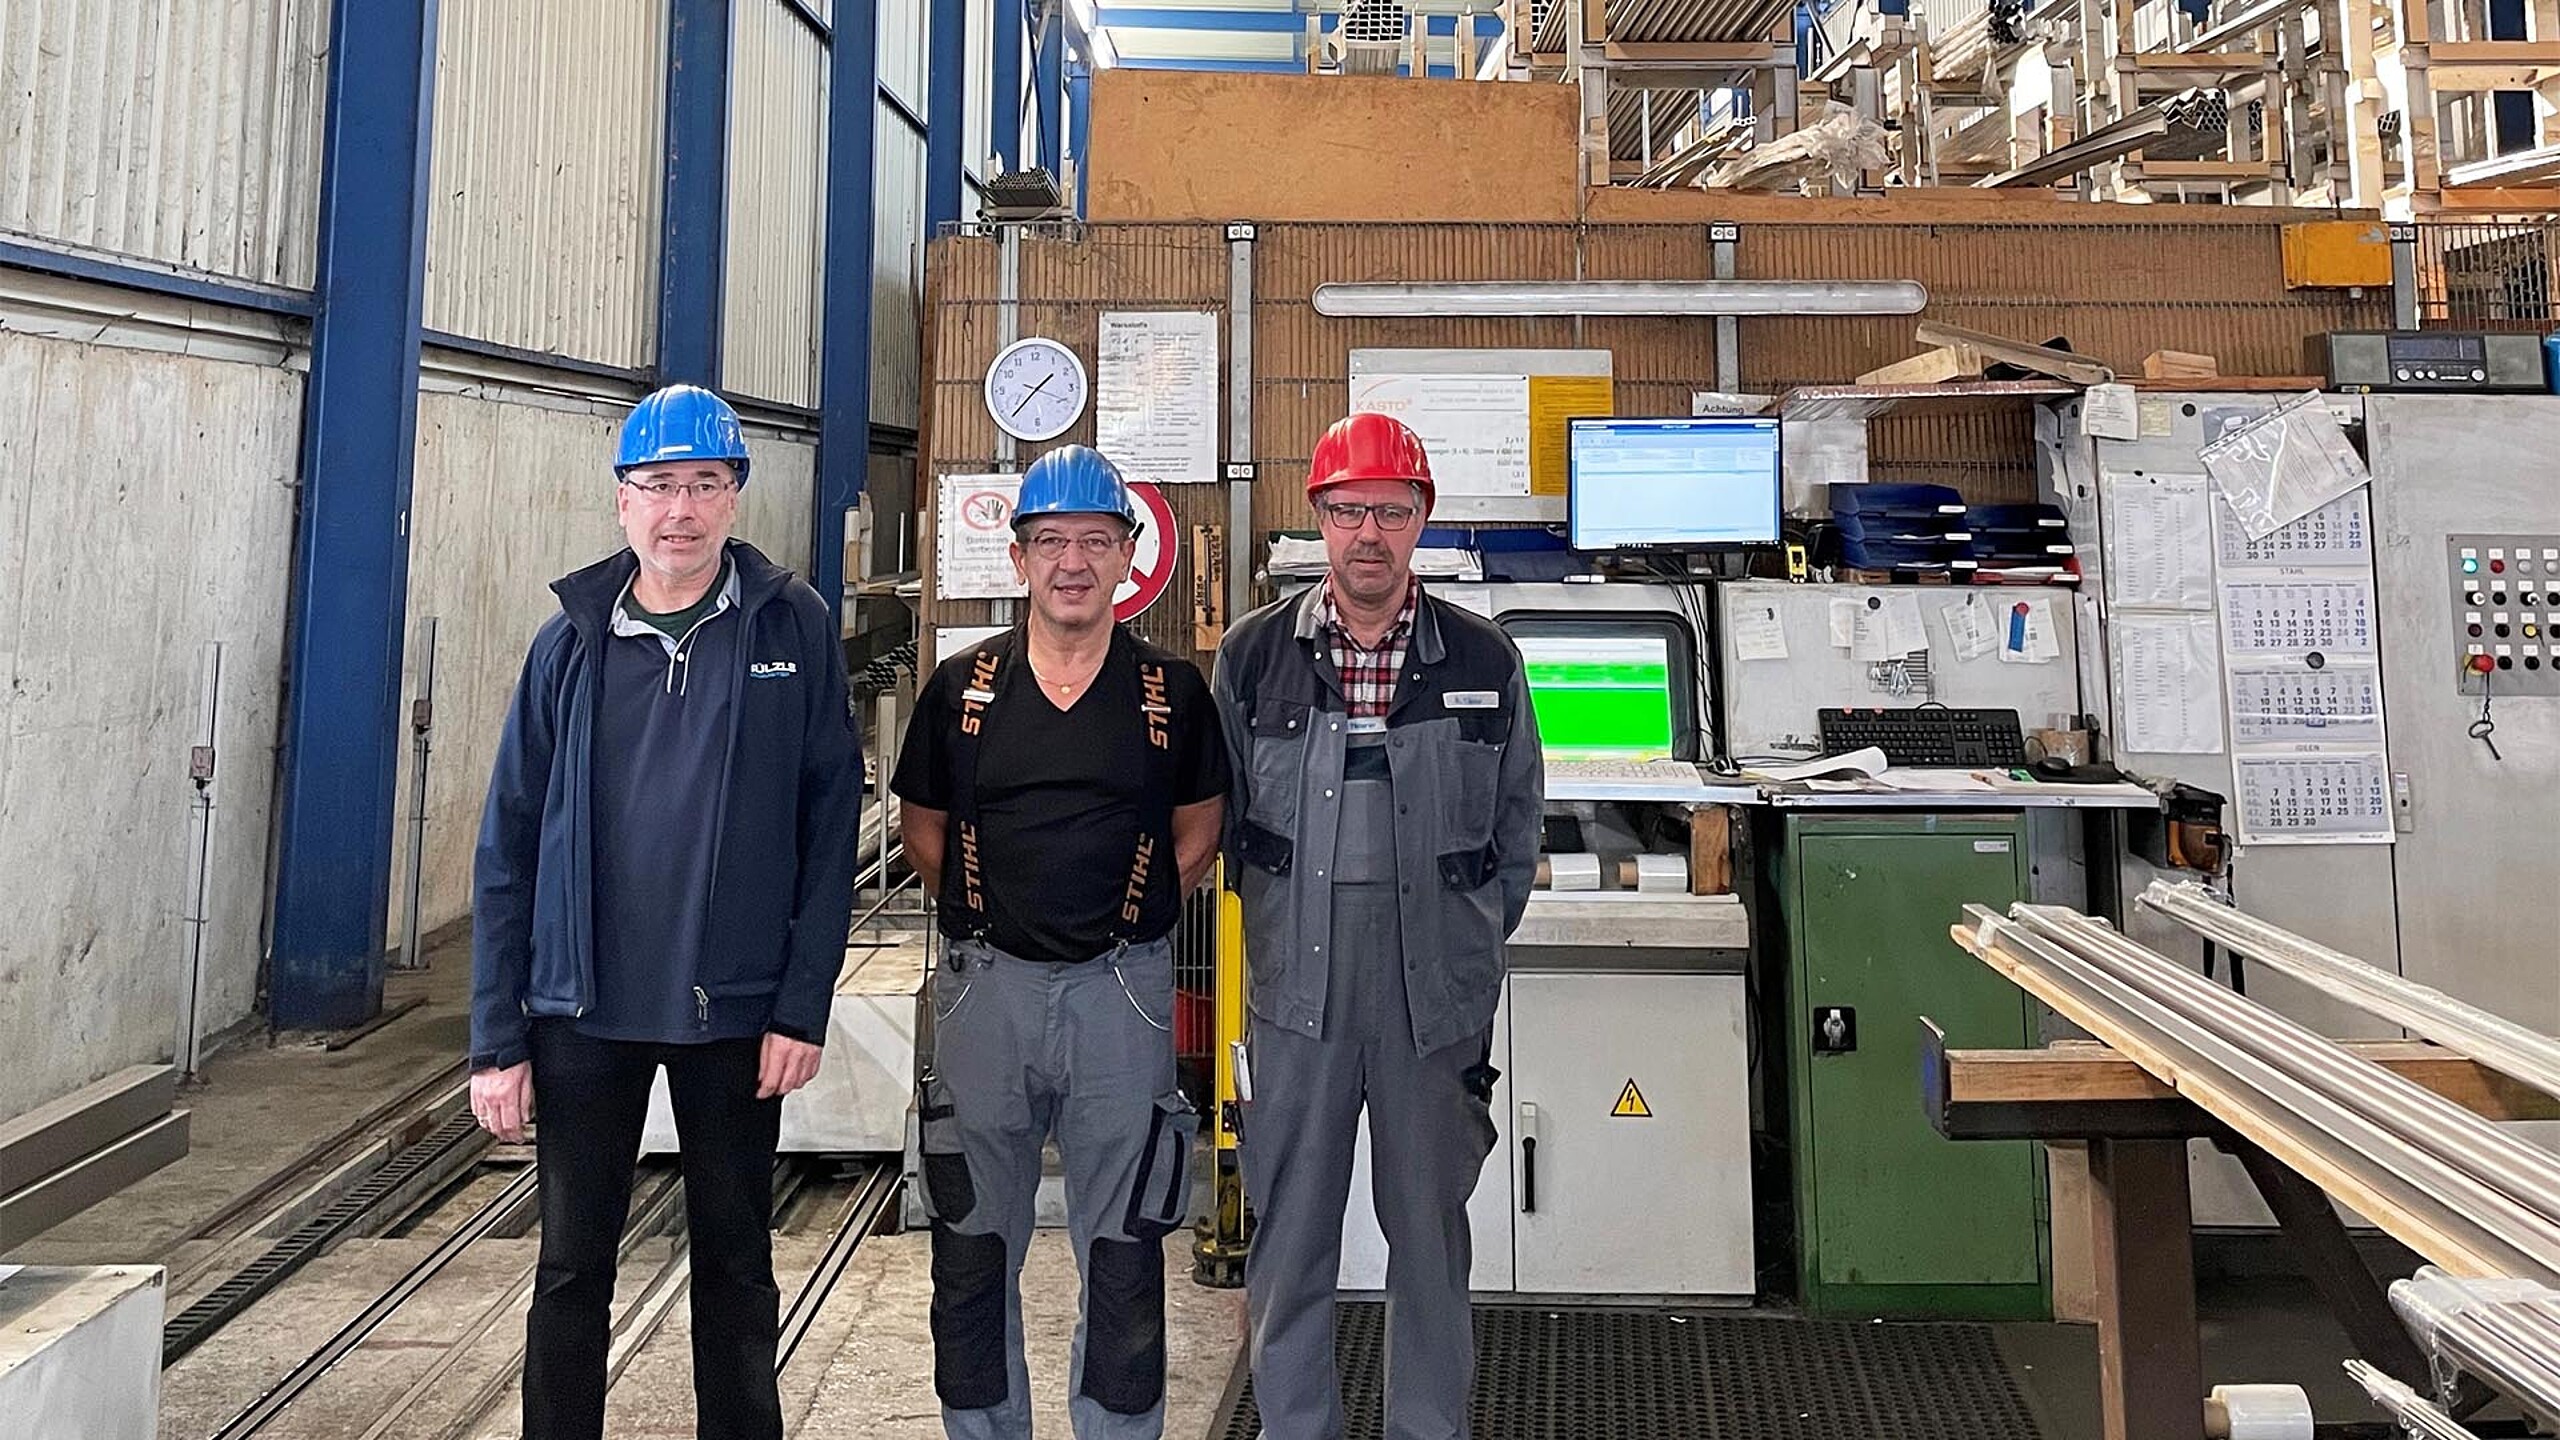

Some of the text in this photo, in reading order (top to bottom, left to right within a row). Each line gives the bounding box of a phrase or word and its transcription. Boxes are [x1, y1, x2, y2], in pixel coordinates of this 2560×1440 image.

[1031, 352, 1040, 361] 12
[1014, 358, 1022, 366] 11
[1004, 370, 1014, 379] 10
[1063, 367, 1069, 376] 2
[1068, 383, 1074, 392] 3
[1703, 404, 1744, 416] Achtung
[962, 656, 999, 736] STHL
[962, 824, 983, 912] STIHL
[1122, 838, 1153, 924] STIHL
